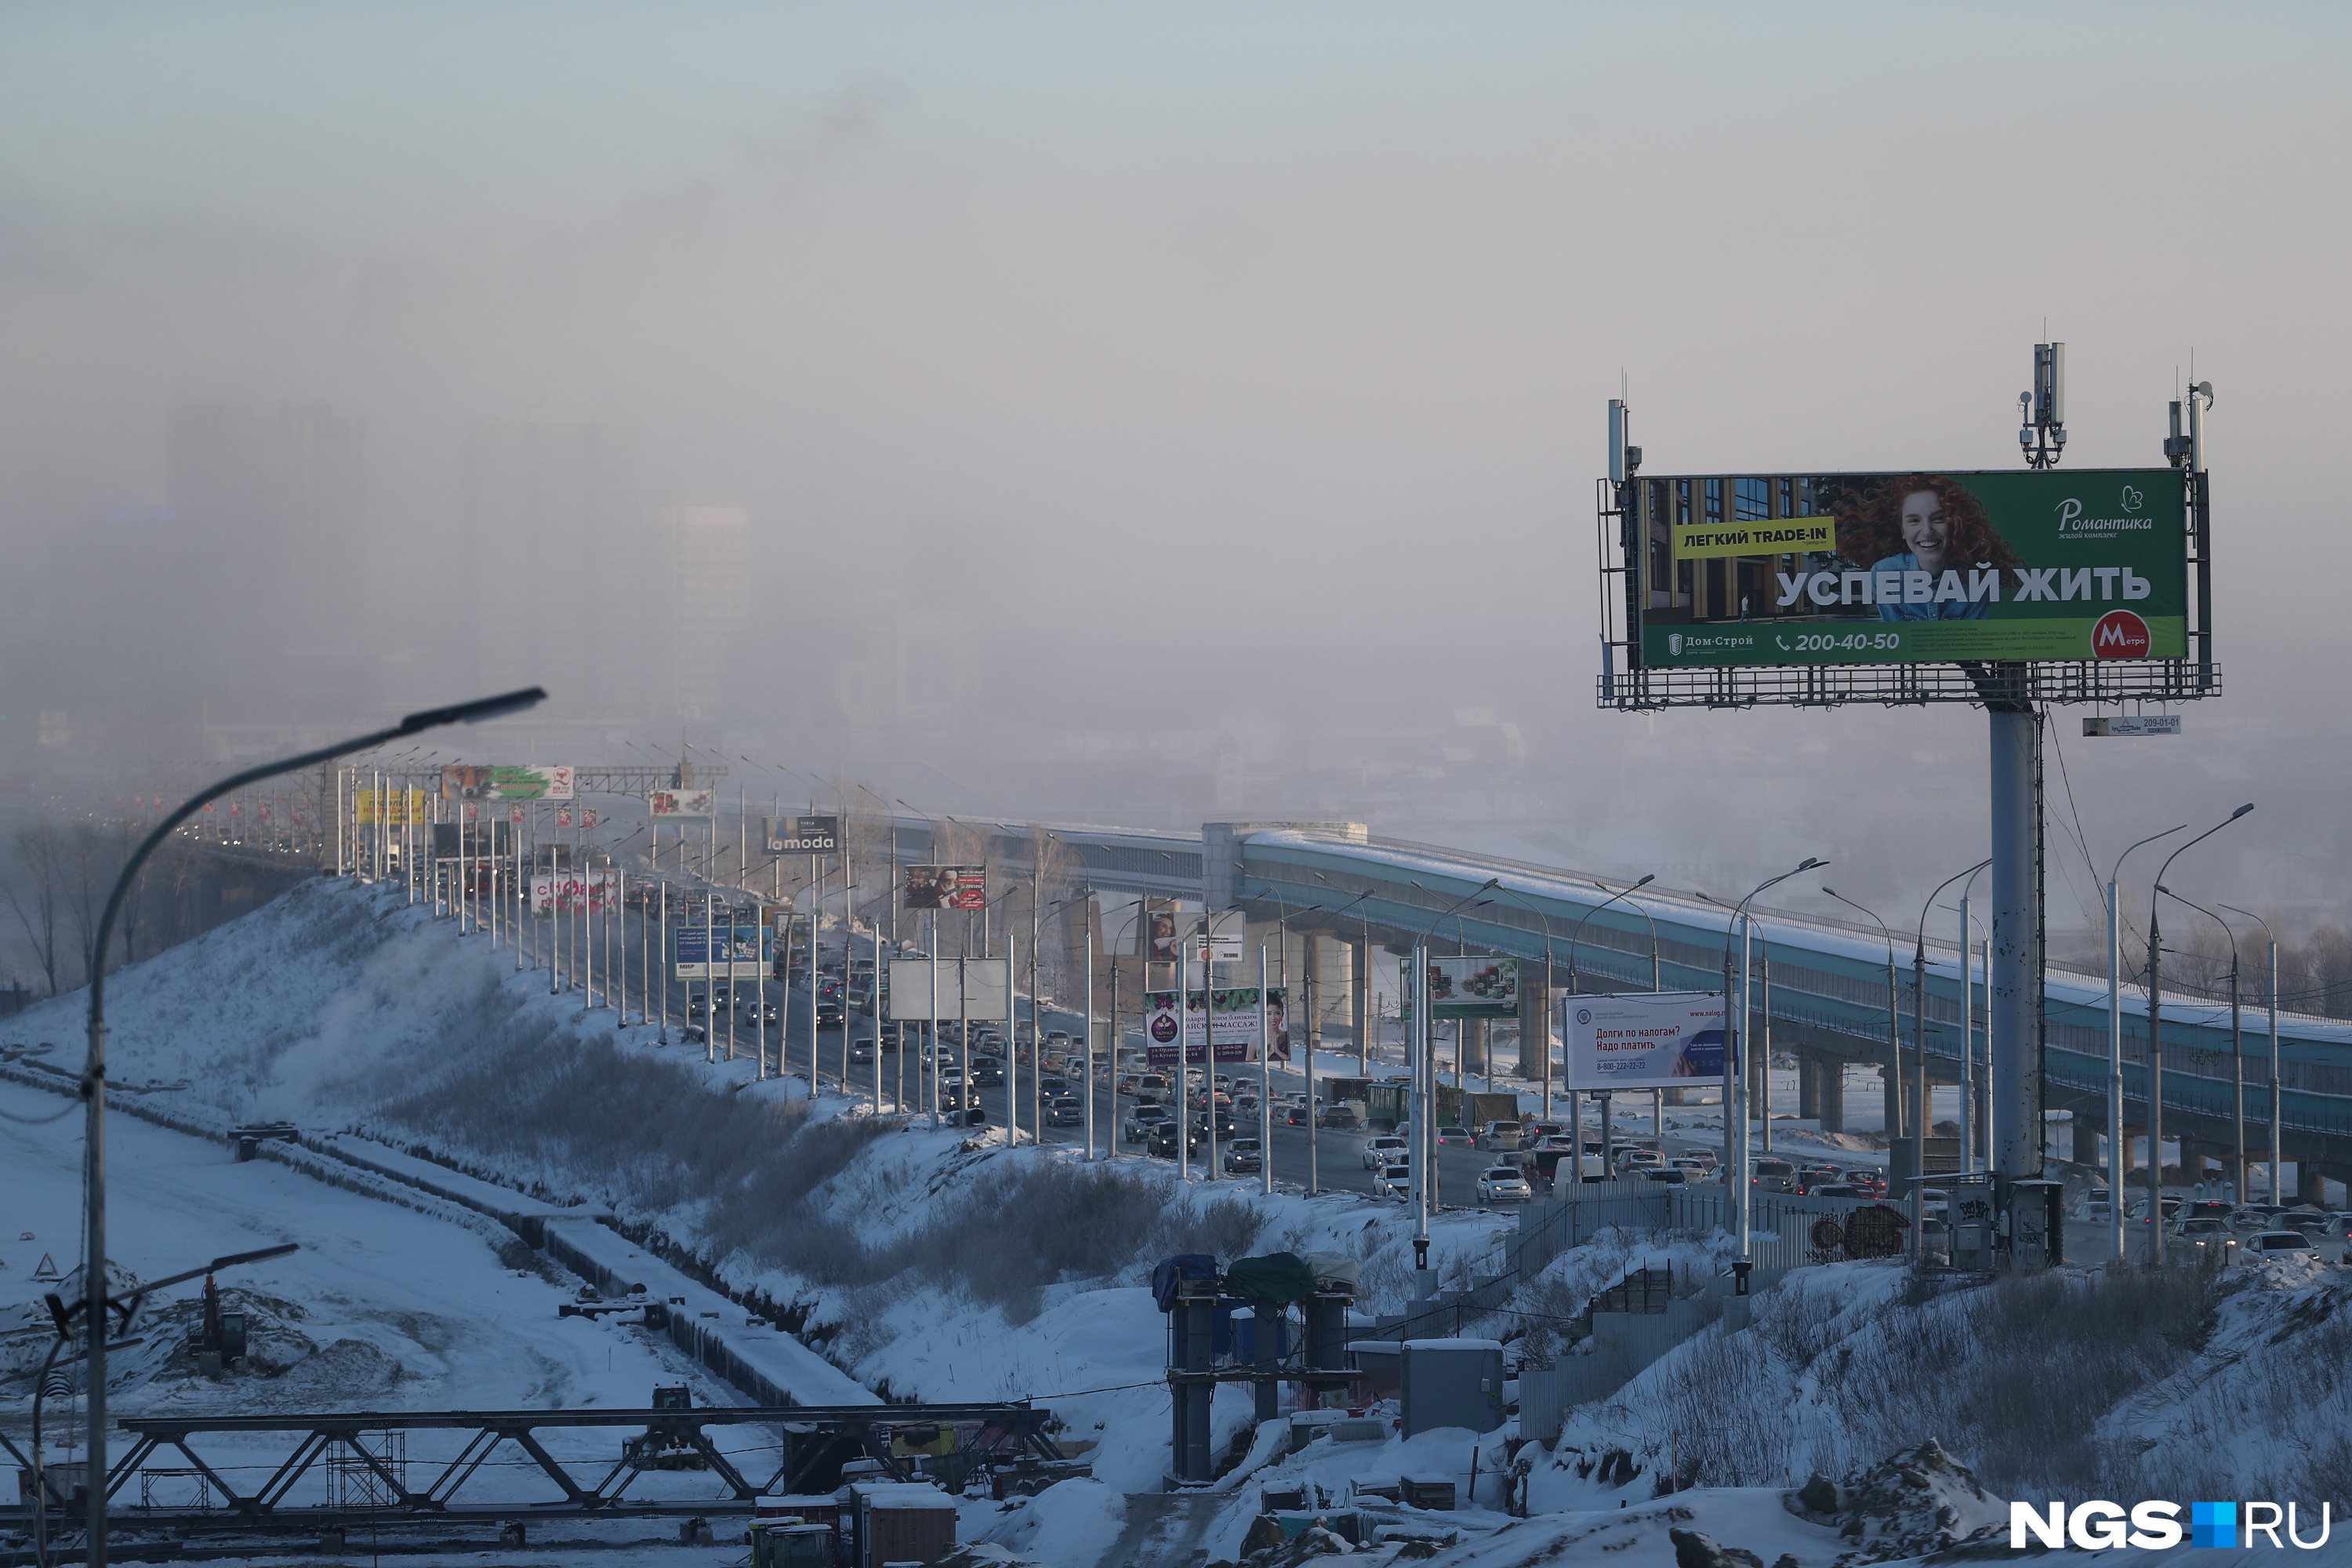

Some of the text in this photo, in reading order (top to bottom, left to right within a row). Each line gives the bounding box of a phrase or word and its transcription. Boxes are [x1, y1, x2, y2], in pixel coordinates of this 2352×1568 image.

[2054, 498, 2153, 531] Романтика
[1684, 530, 1749, 547] ЛЕГКИЙ
[1777, 561, 2152, 606] УСПЕВАЙ ЖИТЬ
[1686, 633, 1900, 651] Дом-Строй 200-40-50
[2099, 622, 2146, 647] Метро
[2144, 718, 2179, 727] 209-01-01
[768, 836, 833, 851] lamoda
[1596, 1025, 1681, 1040] Долги по налогам?
[1596, 1040, 1656, 1052] Надо платить
[1597, 1062, 1646, 1070] 8-800-222-22-22
